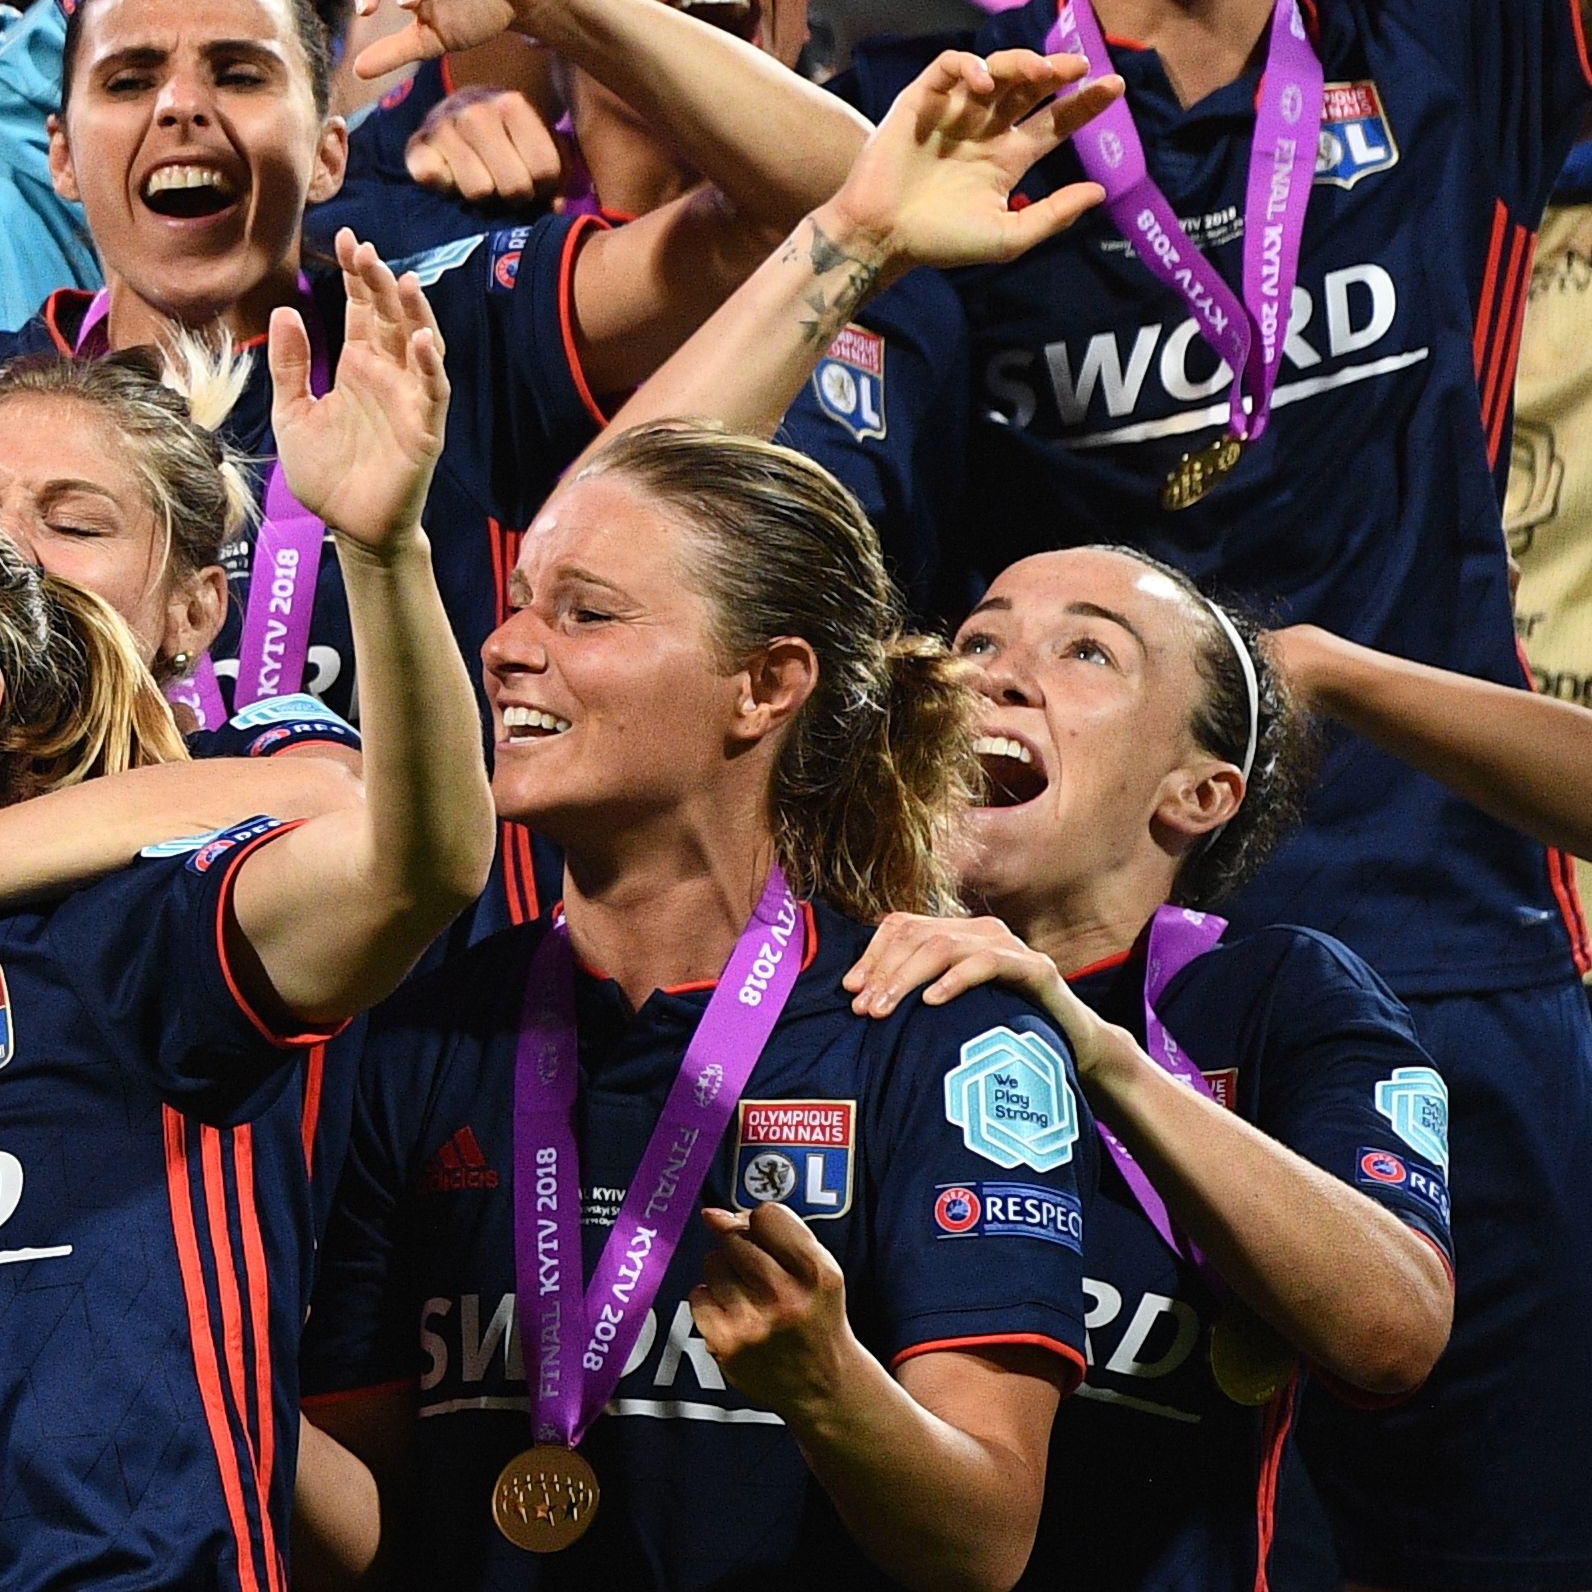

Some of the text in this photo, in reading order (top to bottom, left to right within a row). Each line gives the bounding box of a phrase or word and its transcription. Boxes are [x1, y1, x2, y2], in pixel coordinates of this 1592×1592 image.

[1136, 207, 1180, 268] 2018
[1261, 137, 1298, 364] FINAL KYIV 2018
[1174, 265, 1228, 336] KYIV
[821, 363, 881, 429] OL
[257, 547, 301, 697] KYIV 2018
[738, 941, 784, 1007] 2018
[994, 1073, 1019, 1089] We
[994, 1089, 1030, 1110] Play
[746, 1125, 845, 1143] LYONNAIS
[747, 1109, 845, 1128] OLYMPIQUE
[995, 1104, 1049, 1129] Strong
[592, 1187, 627, 1202] KYIV
[743, 1152, 839, 1207] OL
[535, 1146, 561, 1400] FINAL KYIV 2018
[582, 1127, 700, 1372] FINAL KYIV 2018
